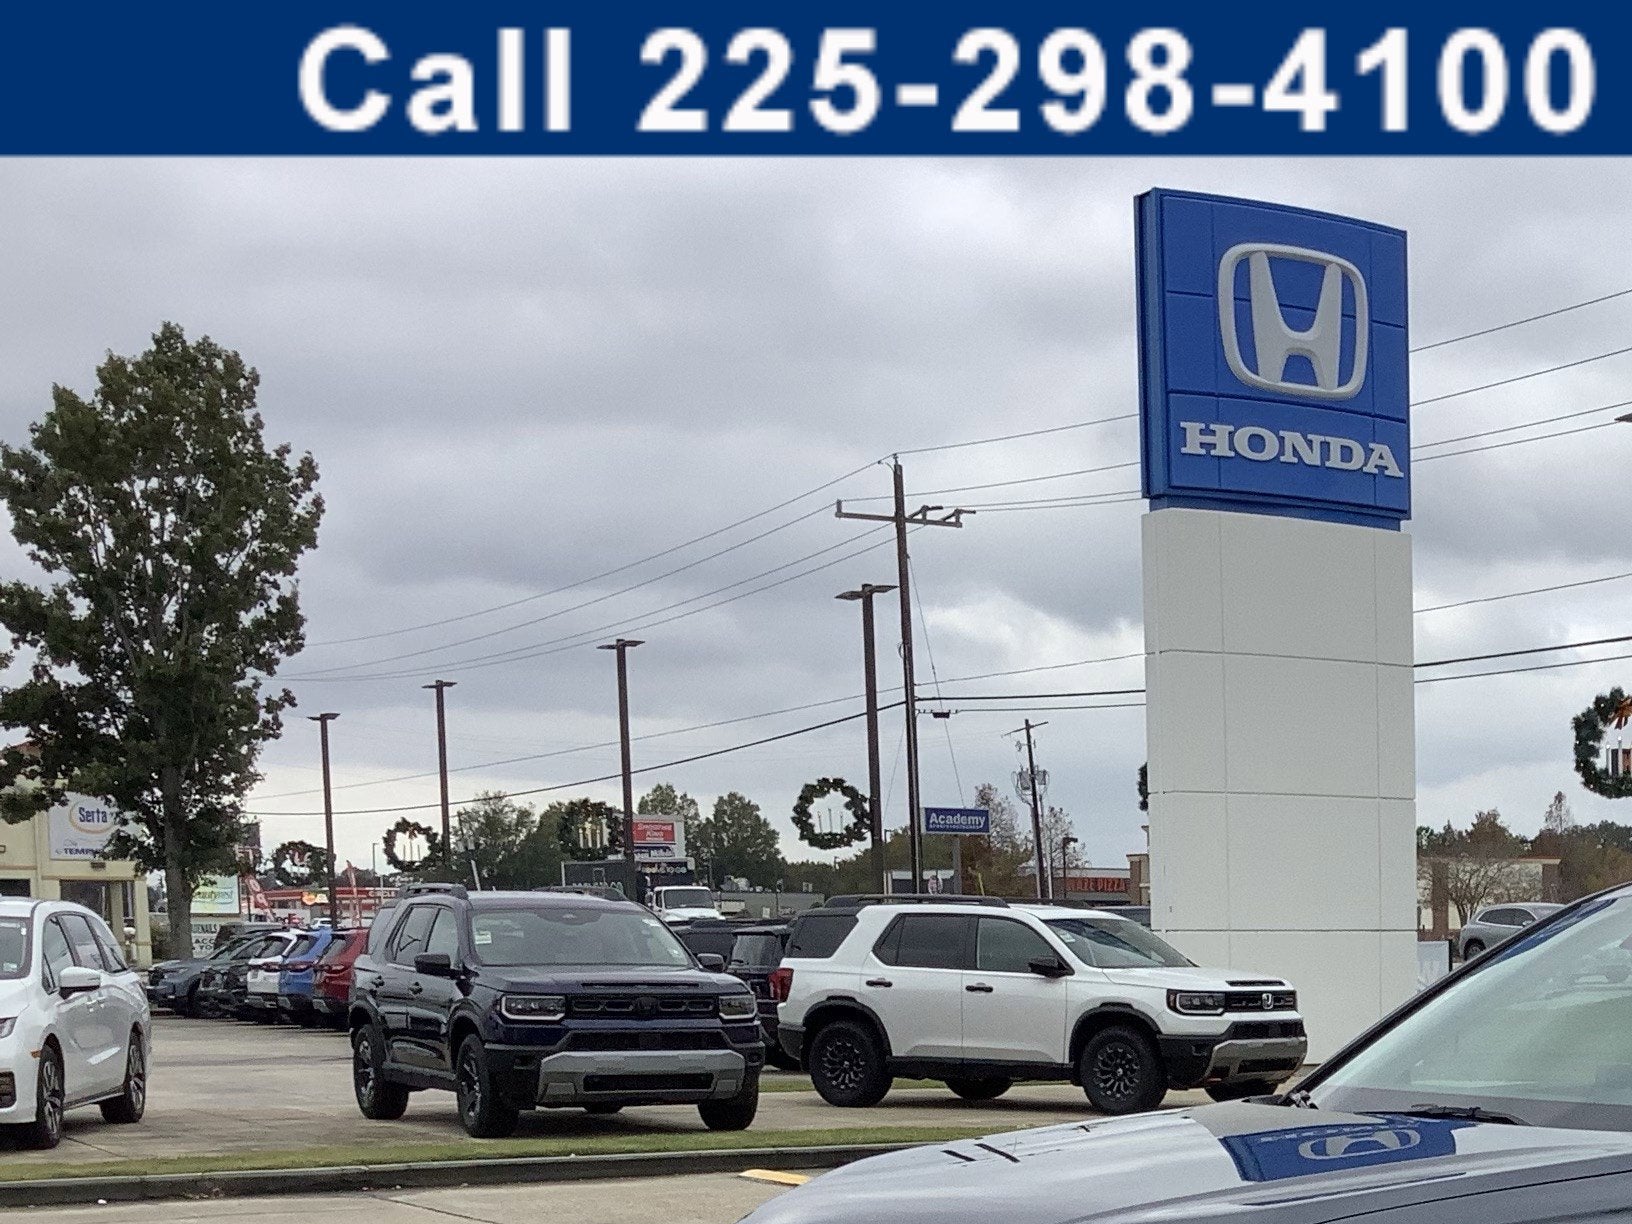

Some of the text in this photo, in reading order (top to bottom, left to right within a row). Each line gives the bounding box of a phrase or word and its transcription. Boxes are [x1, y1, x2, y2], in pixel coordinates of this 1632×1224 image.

[1180, 421, 1404, 478] HONDA
[78, 806, 108, 823] Serta
[929, 812, 985, 829] Academy
